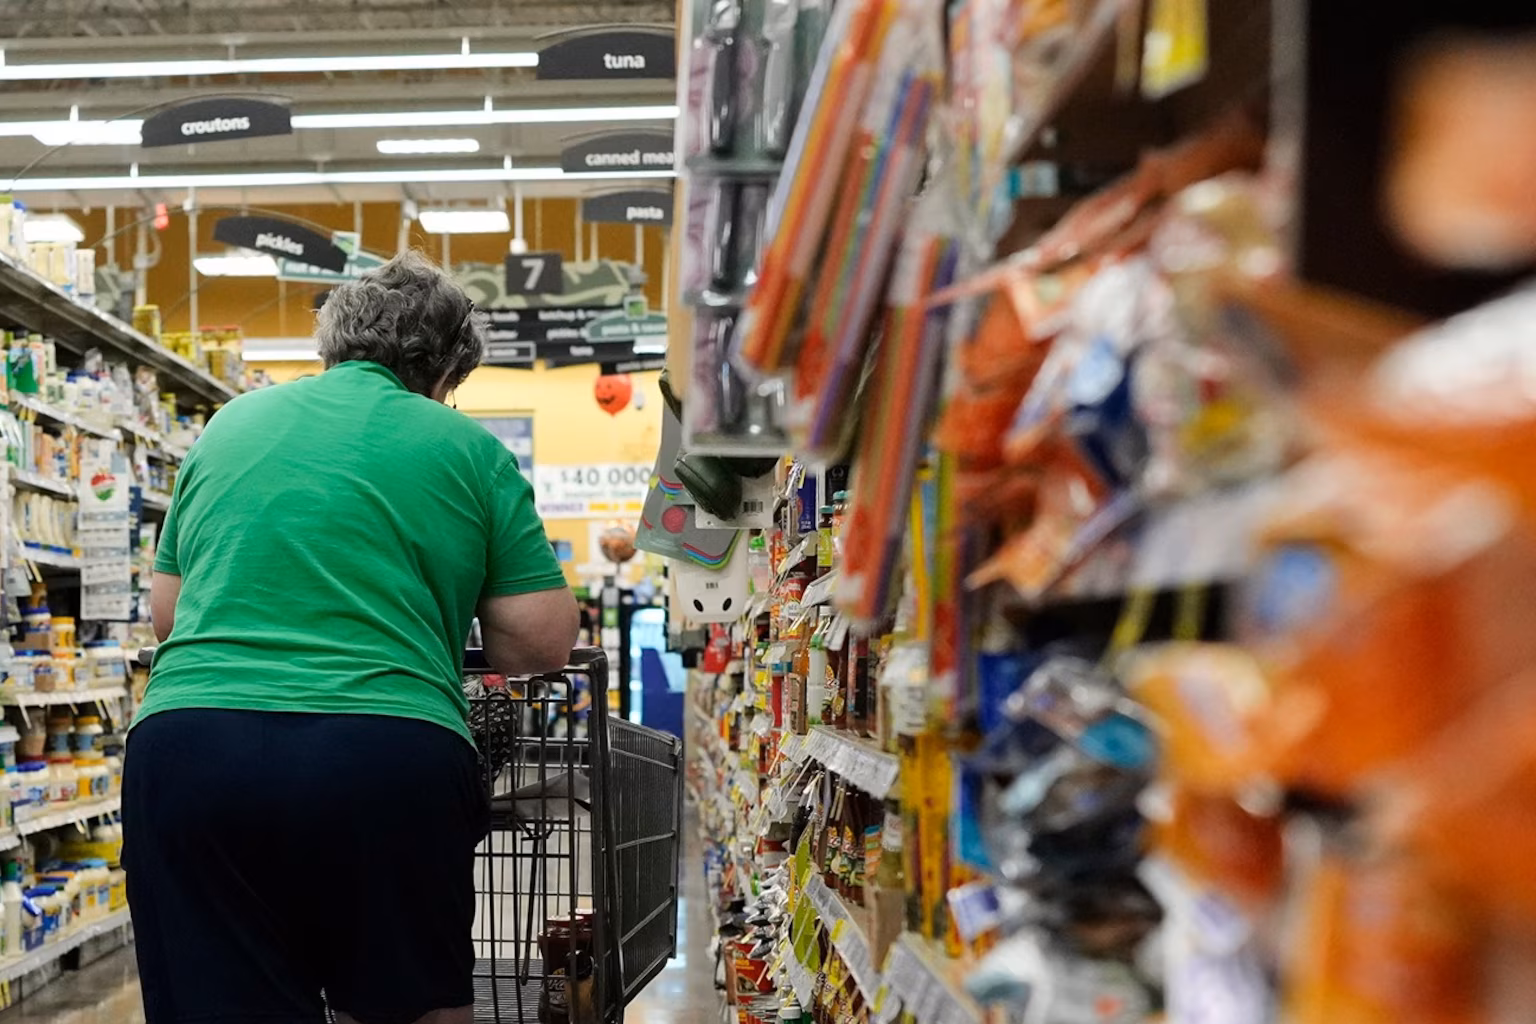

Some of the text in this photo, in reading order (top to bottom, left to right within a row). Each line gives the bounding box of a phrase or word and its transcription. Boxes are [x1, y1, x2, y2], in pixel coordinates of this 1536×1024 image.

[604, 52, 646, 71] tuna
[181, 114, 251, 135] croutons
[585, 149, 676, 167] canned mea
[626, 206, 664, 221] pasta
[255, 231, 305, 256] pickles
[520, 258, 546, 290] 7
